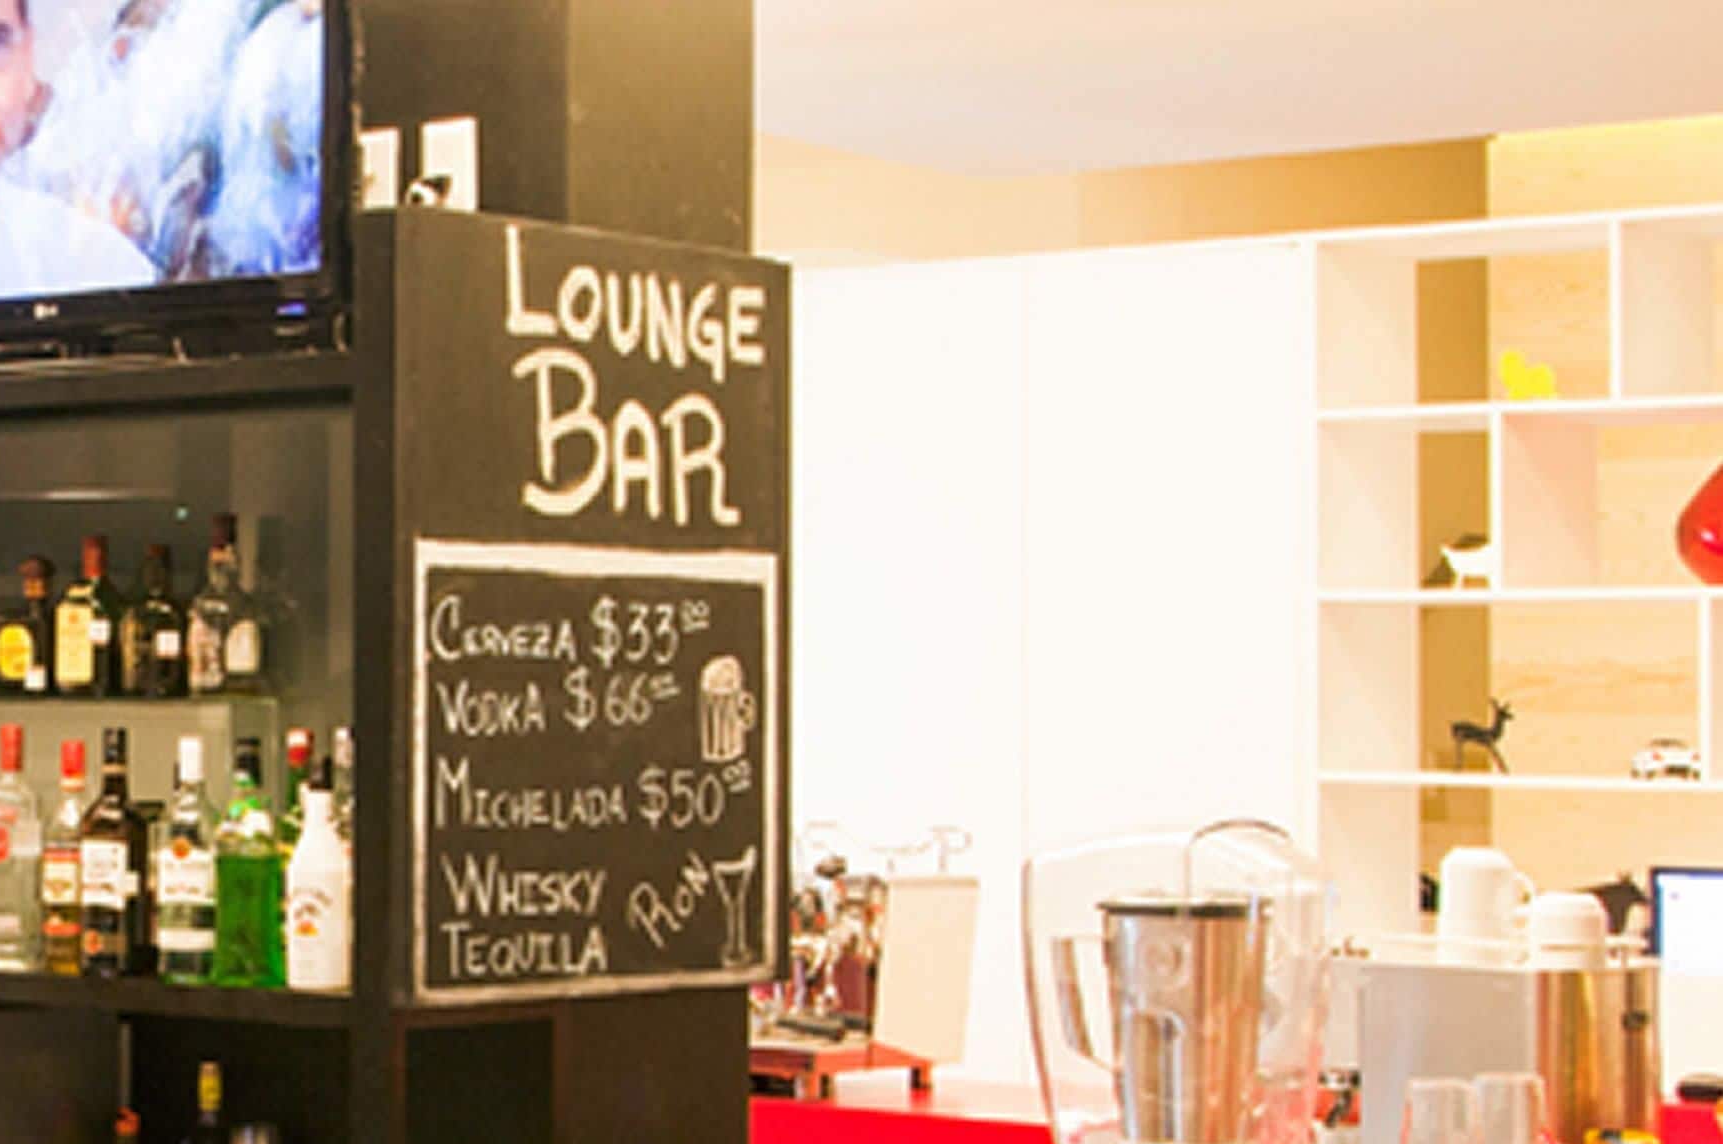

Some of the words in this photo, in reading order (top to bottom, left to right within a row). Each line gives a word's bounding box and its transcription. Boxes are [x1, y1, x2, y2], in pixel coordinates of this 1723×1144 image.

[505, 224, 765, 384] LOUNGE
[511, 346, 741, 527] BAR
[430, 594, 577, 662] CERVEZA
[436, 679, 547, 737] VODKA
[434, 756, 627, 831] MICHELADA
[440, 852, 606, 918] WHISKY
[440, 924, 609, 978] TEQUILA
